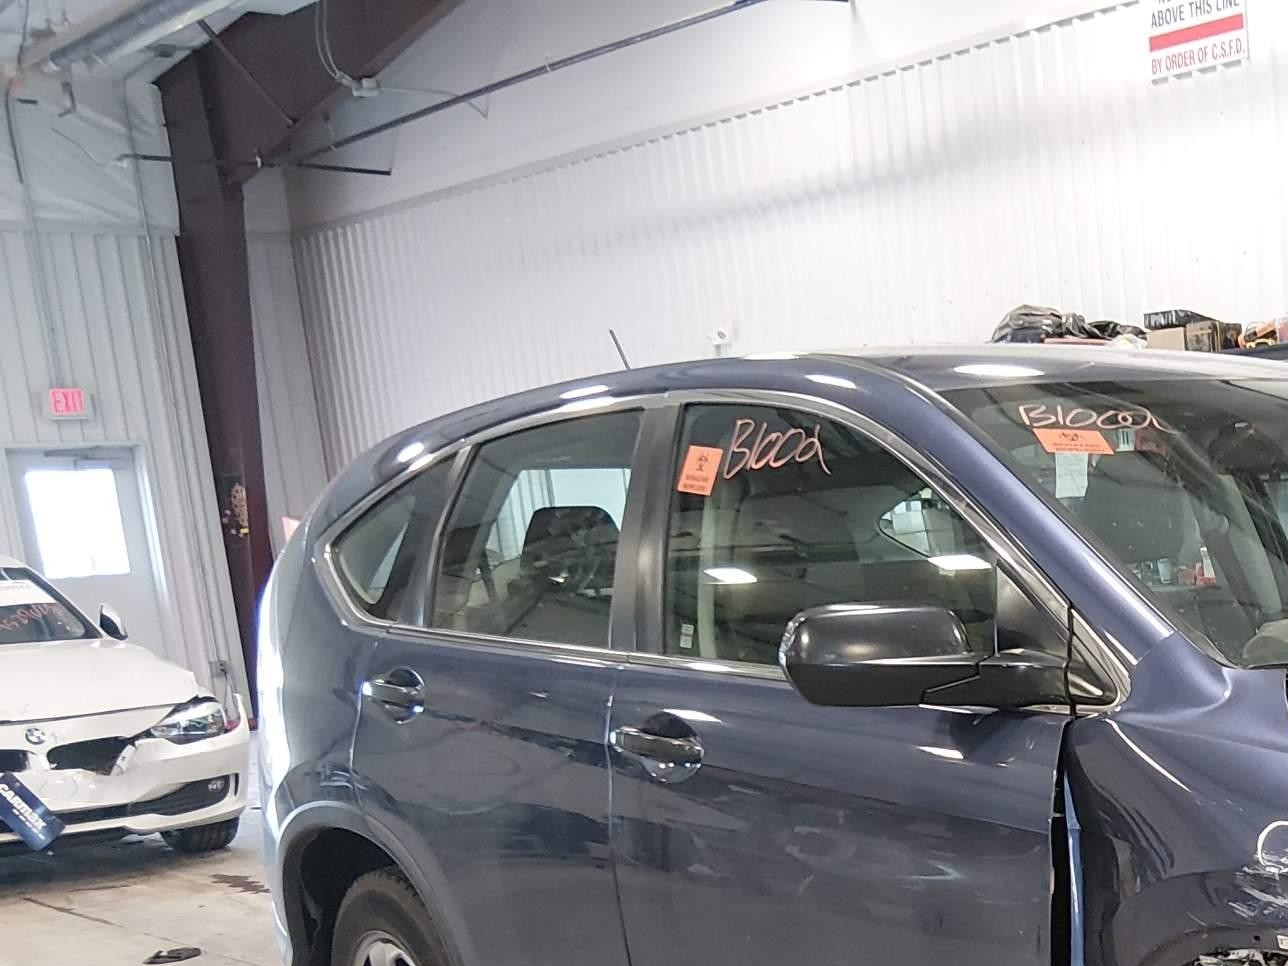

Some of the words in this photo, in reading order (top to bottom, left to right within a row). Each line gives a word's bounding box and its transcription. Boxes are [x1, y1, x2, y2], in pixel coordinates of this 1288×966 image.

[1151, 4, 1185, 29] ABOVE
[1188, 0, 1213, 18] THIS
[1151, 57, 1163, 75] BY
[1165, 50, 1197, 72] ORDER
[1197, 46, 1208, 63] OF
[51, 389, 82, 413] EXIT
[724, 418, 832, 480] Blood
